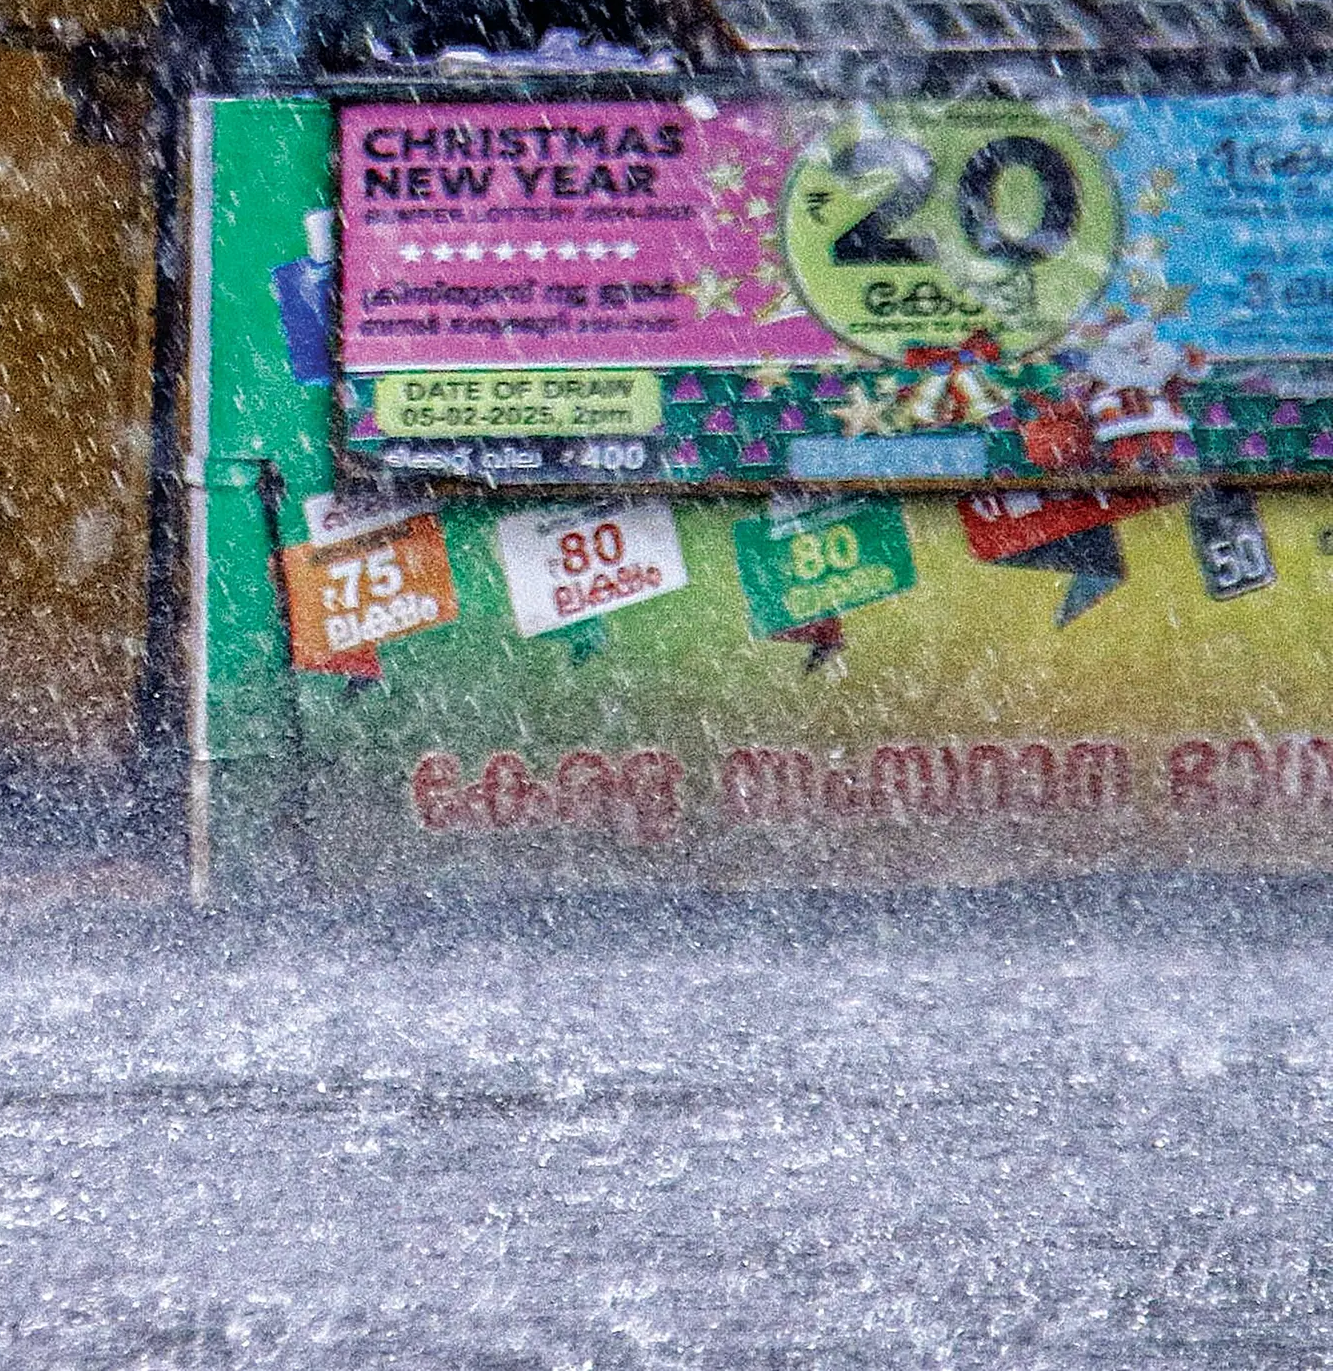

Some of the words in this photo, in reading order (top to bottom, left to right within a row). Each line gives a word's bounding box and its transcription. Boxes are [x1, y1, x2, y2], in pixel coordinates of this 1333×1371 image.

[362, 124, 685, 161] CHRISTMAS
[364, 166, 493, 200] NEW
[514, 163, 657, 198] YEAR
[405, 380, 482, 402] DATE
[492, 379, 533, 401] OF
[543, 378, 636, 400] DRAW
[572, 406, 634, 428] 2pm
